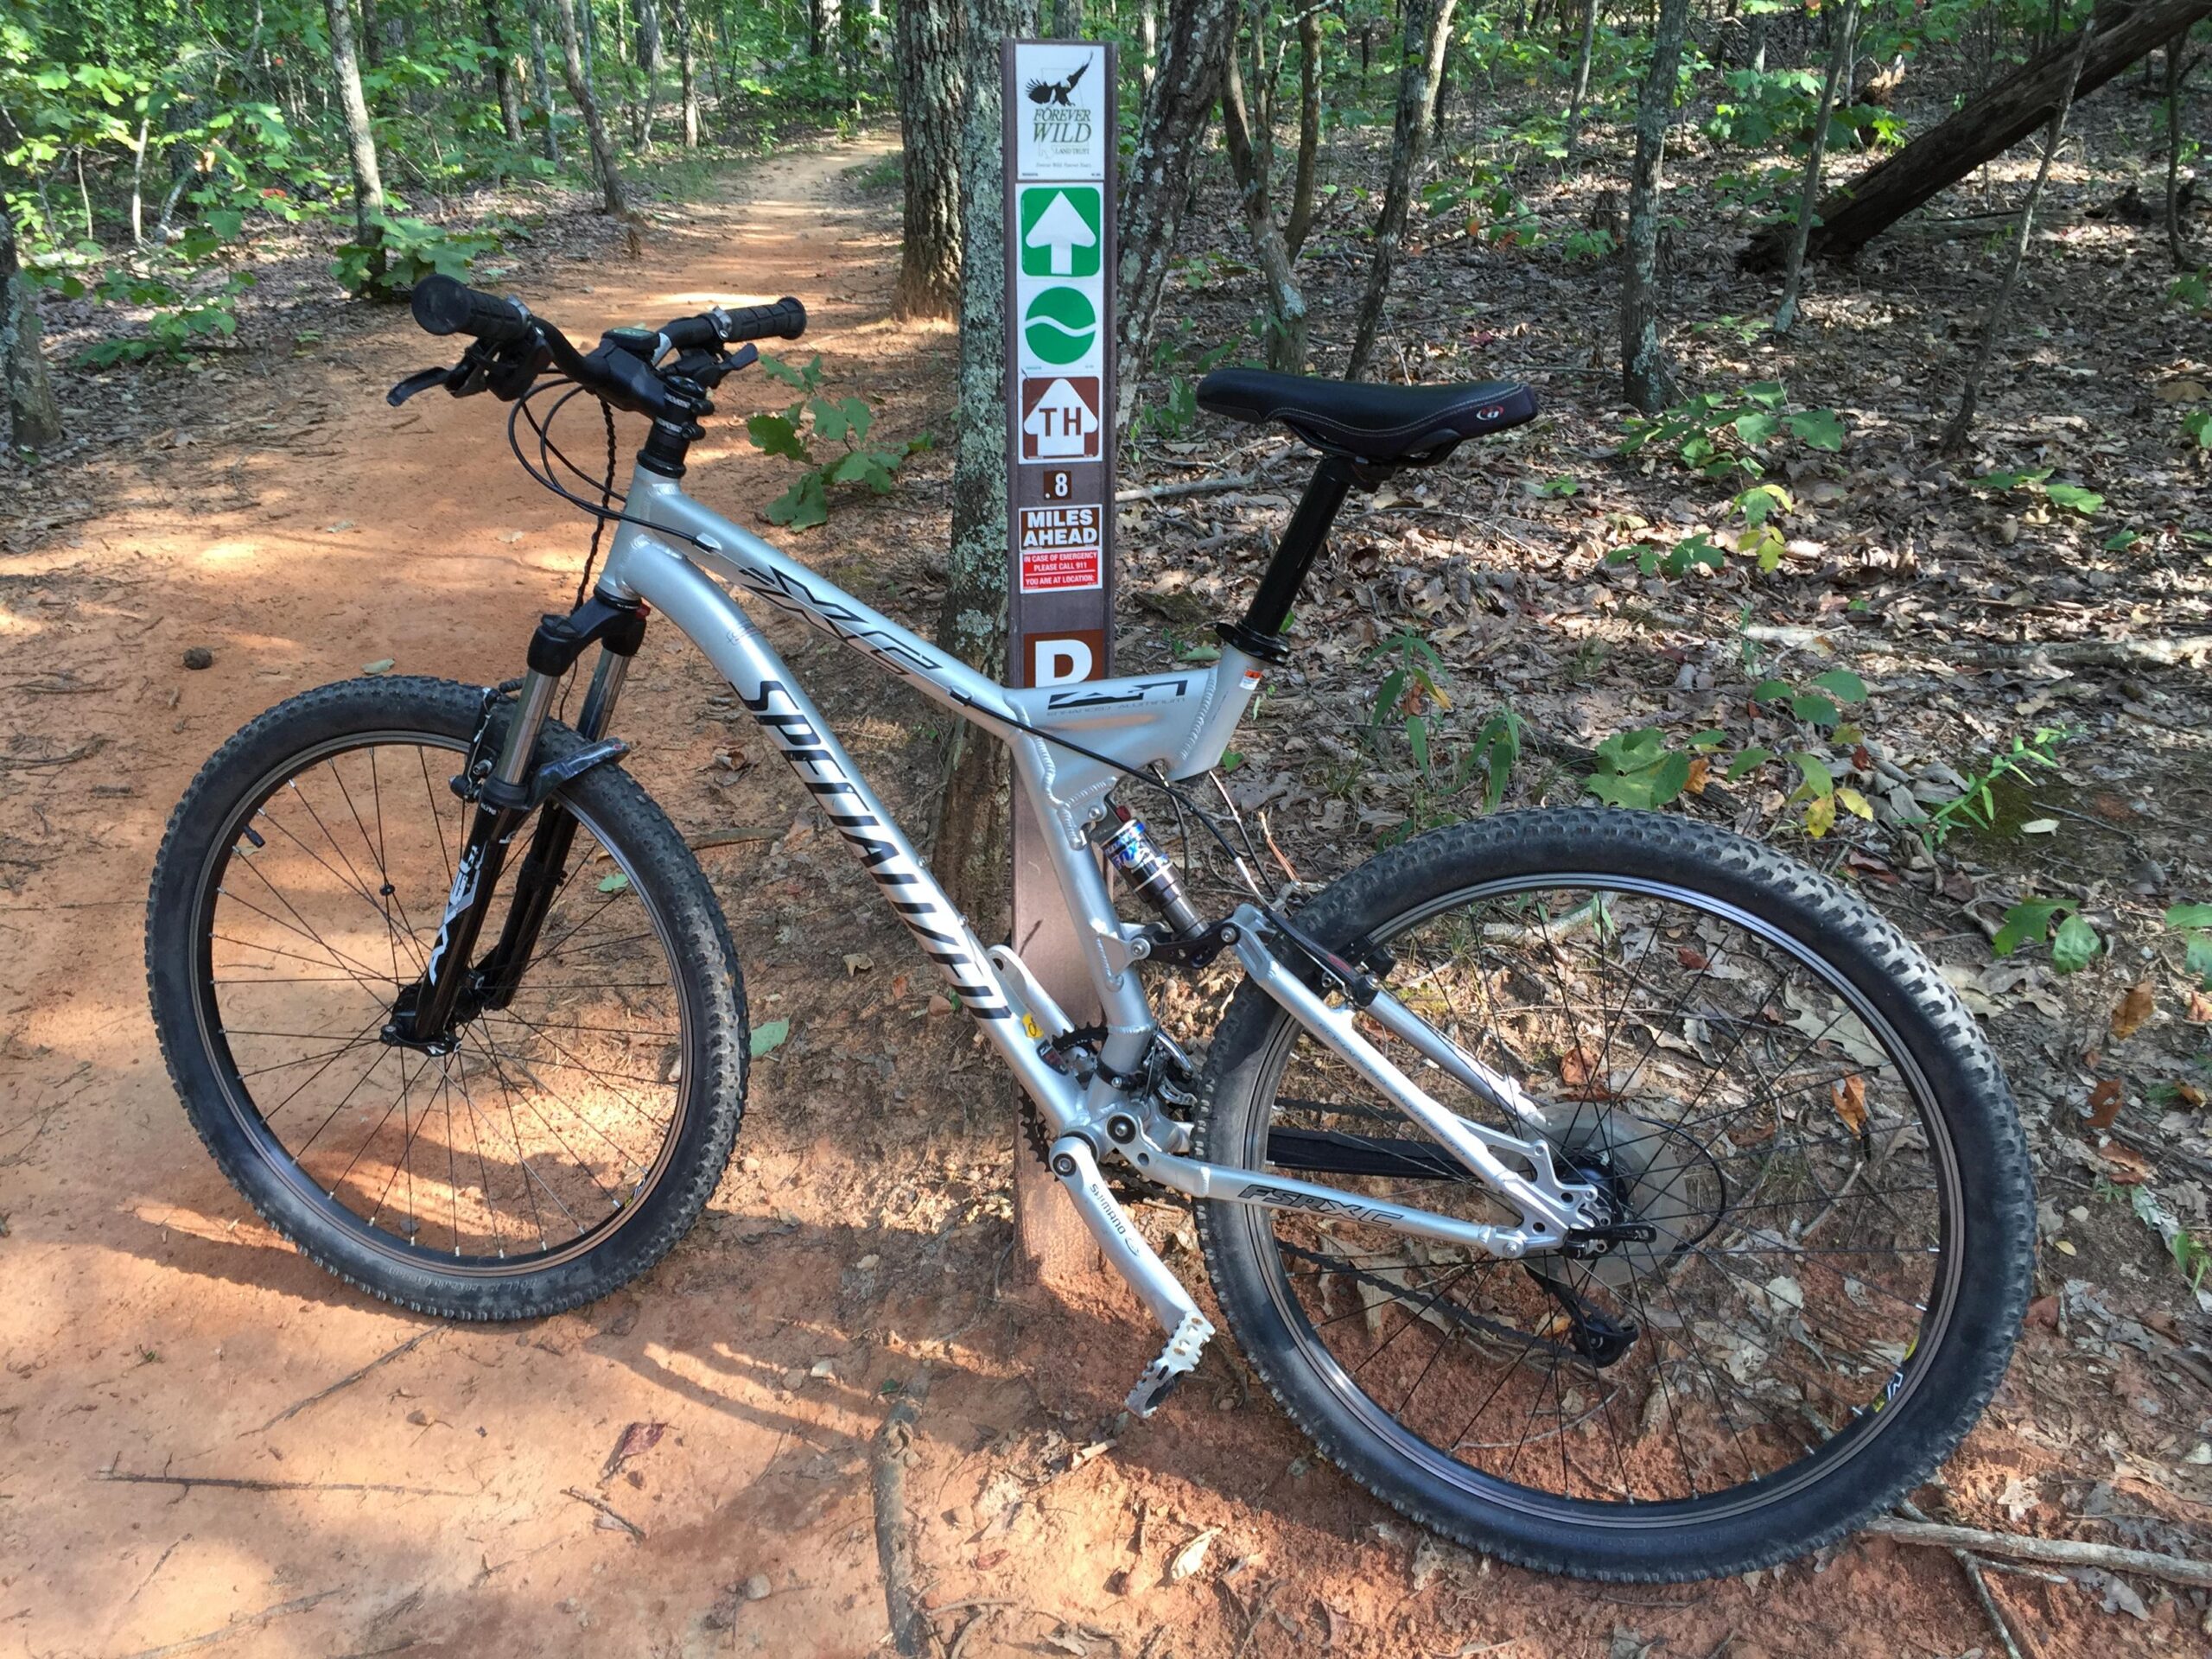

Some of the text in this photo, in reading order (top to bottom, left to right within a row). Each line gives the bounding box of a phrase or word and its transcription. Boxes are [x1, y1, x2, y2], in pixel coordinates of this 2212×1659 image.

[1033, 108, 1091, 122] FOREVER
[1033, 123, 1092, 143] WILD
[1039, 407, 1081, 436] TH
[1027, 509, 1093, 528] MILES
[1023, 527, 1097, 547] AHEAD
[1032, 554, 1049, 563] CASE
[1059, 551, 1097, 560] EMERGENCY
[1033, 563, 1058, 572] PLEASE
[1090, 1183, 1127, 1235] SHIMANO
